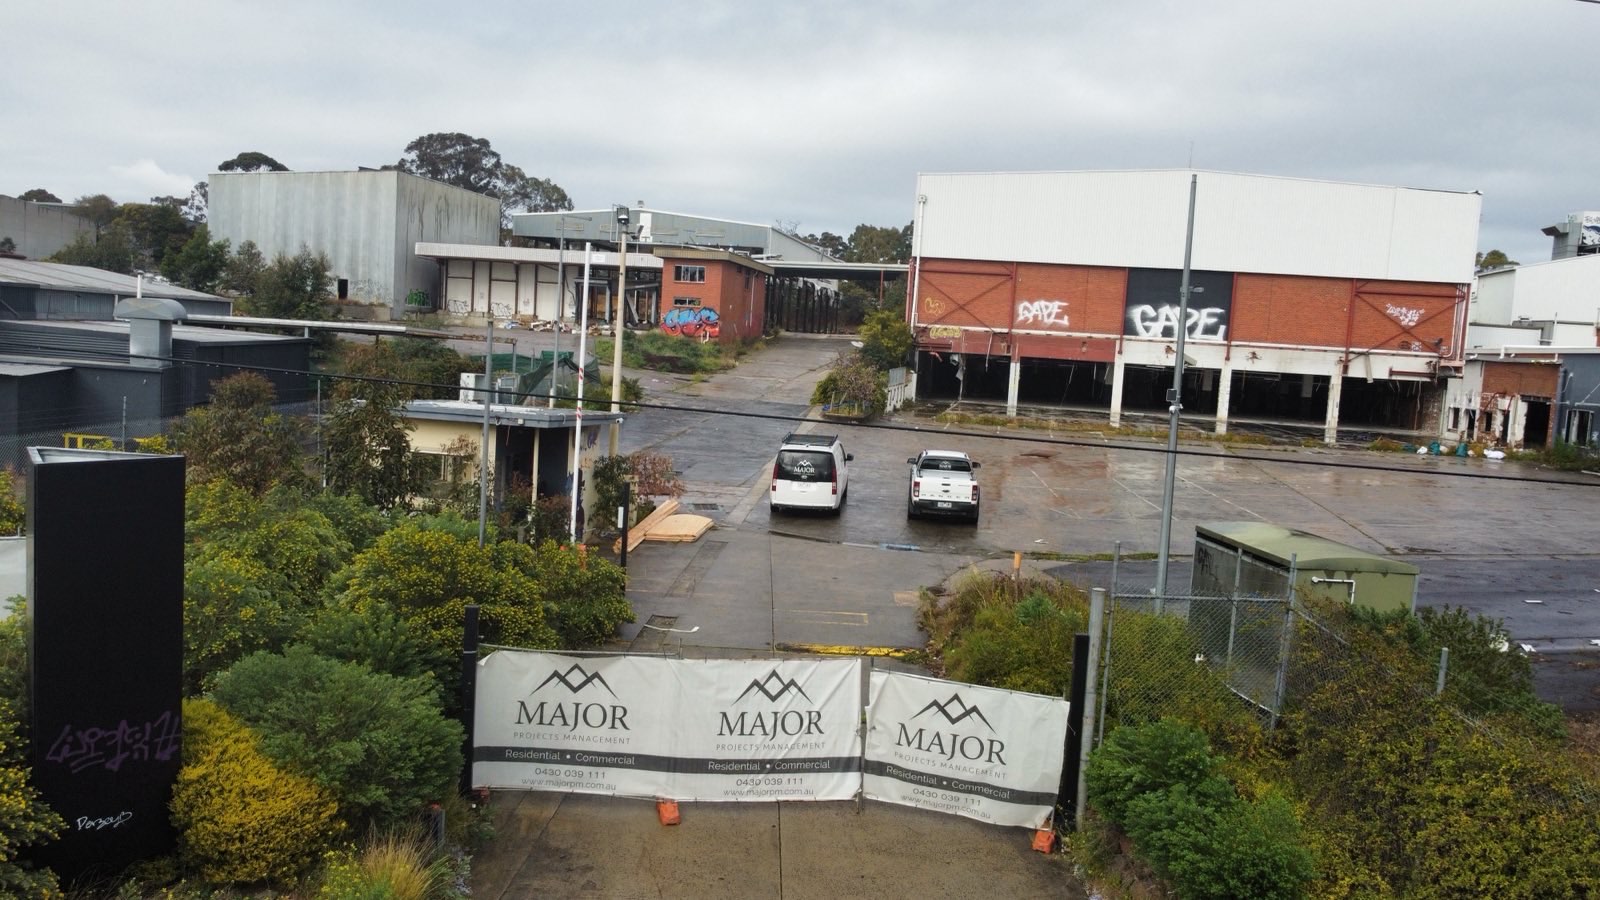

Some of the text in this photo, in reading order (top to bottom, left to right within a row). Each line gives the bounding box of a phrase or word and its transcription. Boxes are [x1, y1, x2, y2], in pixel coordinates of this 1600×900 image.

[793, 466, 815, 474] MAJOR
[514, 700, 631, 732] MAJOR
[717, 710, 824, 741] MAJOR
[513, 731, 631, 745] PROJECTS MANAGEMENT
[895, 722, 1007, 765] MAJOR
[716, 742, 826, 751] PROJECTS MANAGEMENT
[505, 749, 635, 765] Residential Commercial
[534, 767, 606, 779] 0430 039 111
[708, 760, 830, 771] Residential Commercial
[894, 751, 1007, 780] PROJECTS MANAGEMENT
[521, 779, 617, 791] www.majorpm.com.au
[736, 778, 762, 787] 0430
[764, 778, 783, 786] 039
[886, 765, 1010, 799] Residential Commercial
[723, 788, 814, 797] www.majorpm.com.au
[912, 787, 981, 807] 0430 039 111
[901, 794, 991, 819] www.majorpm.com.au
